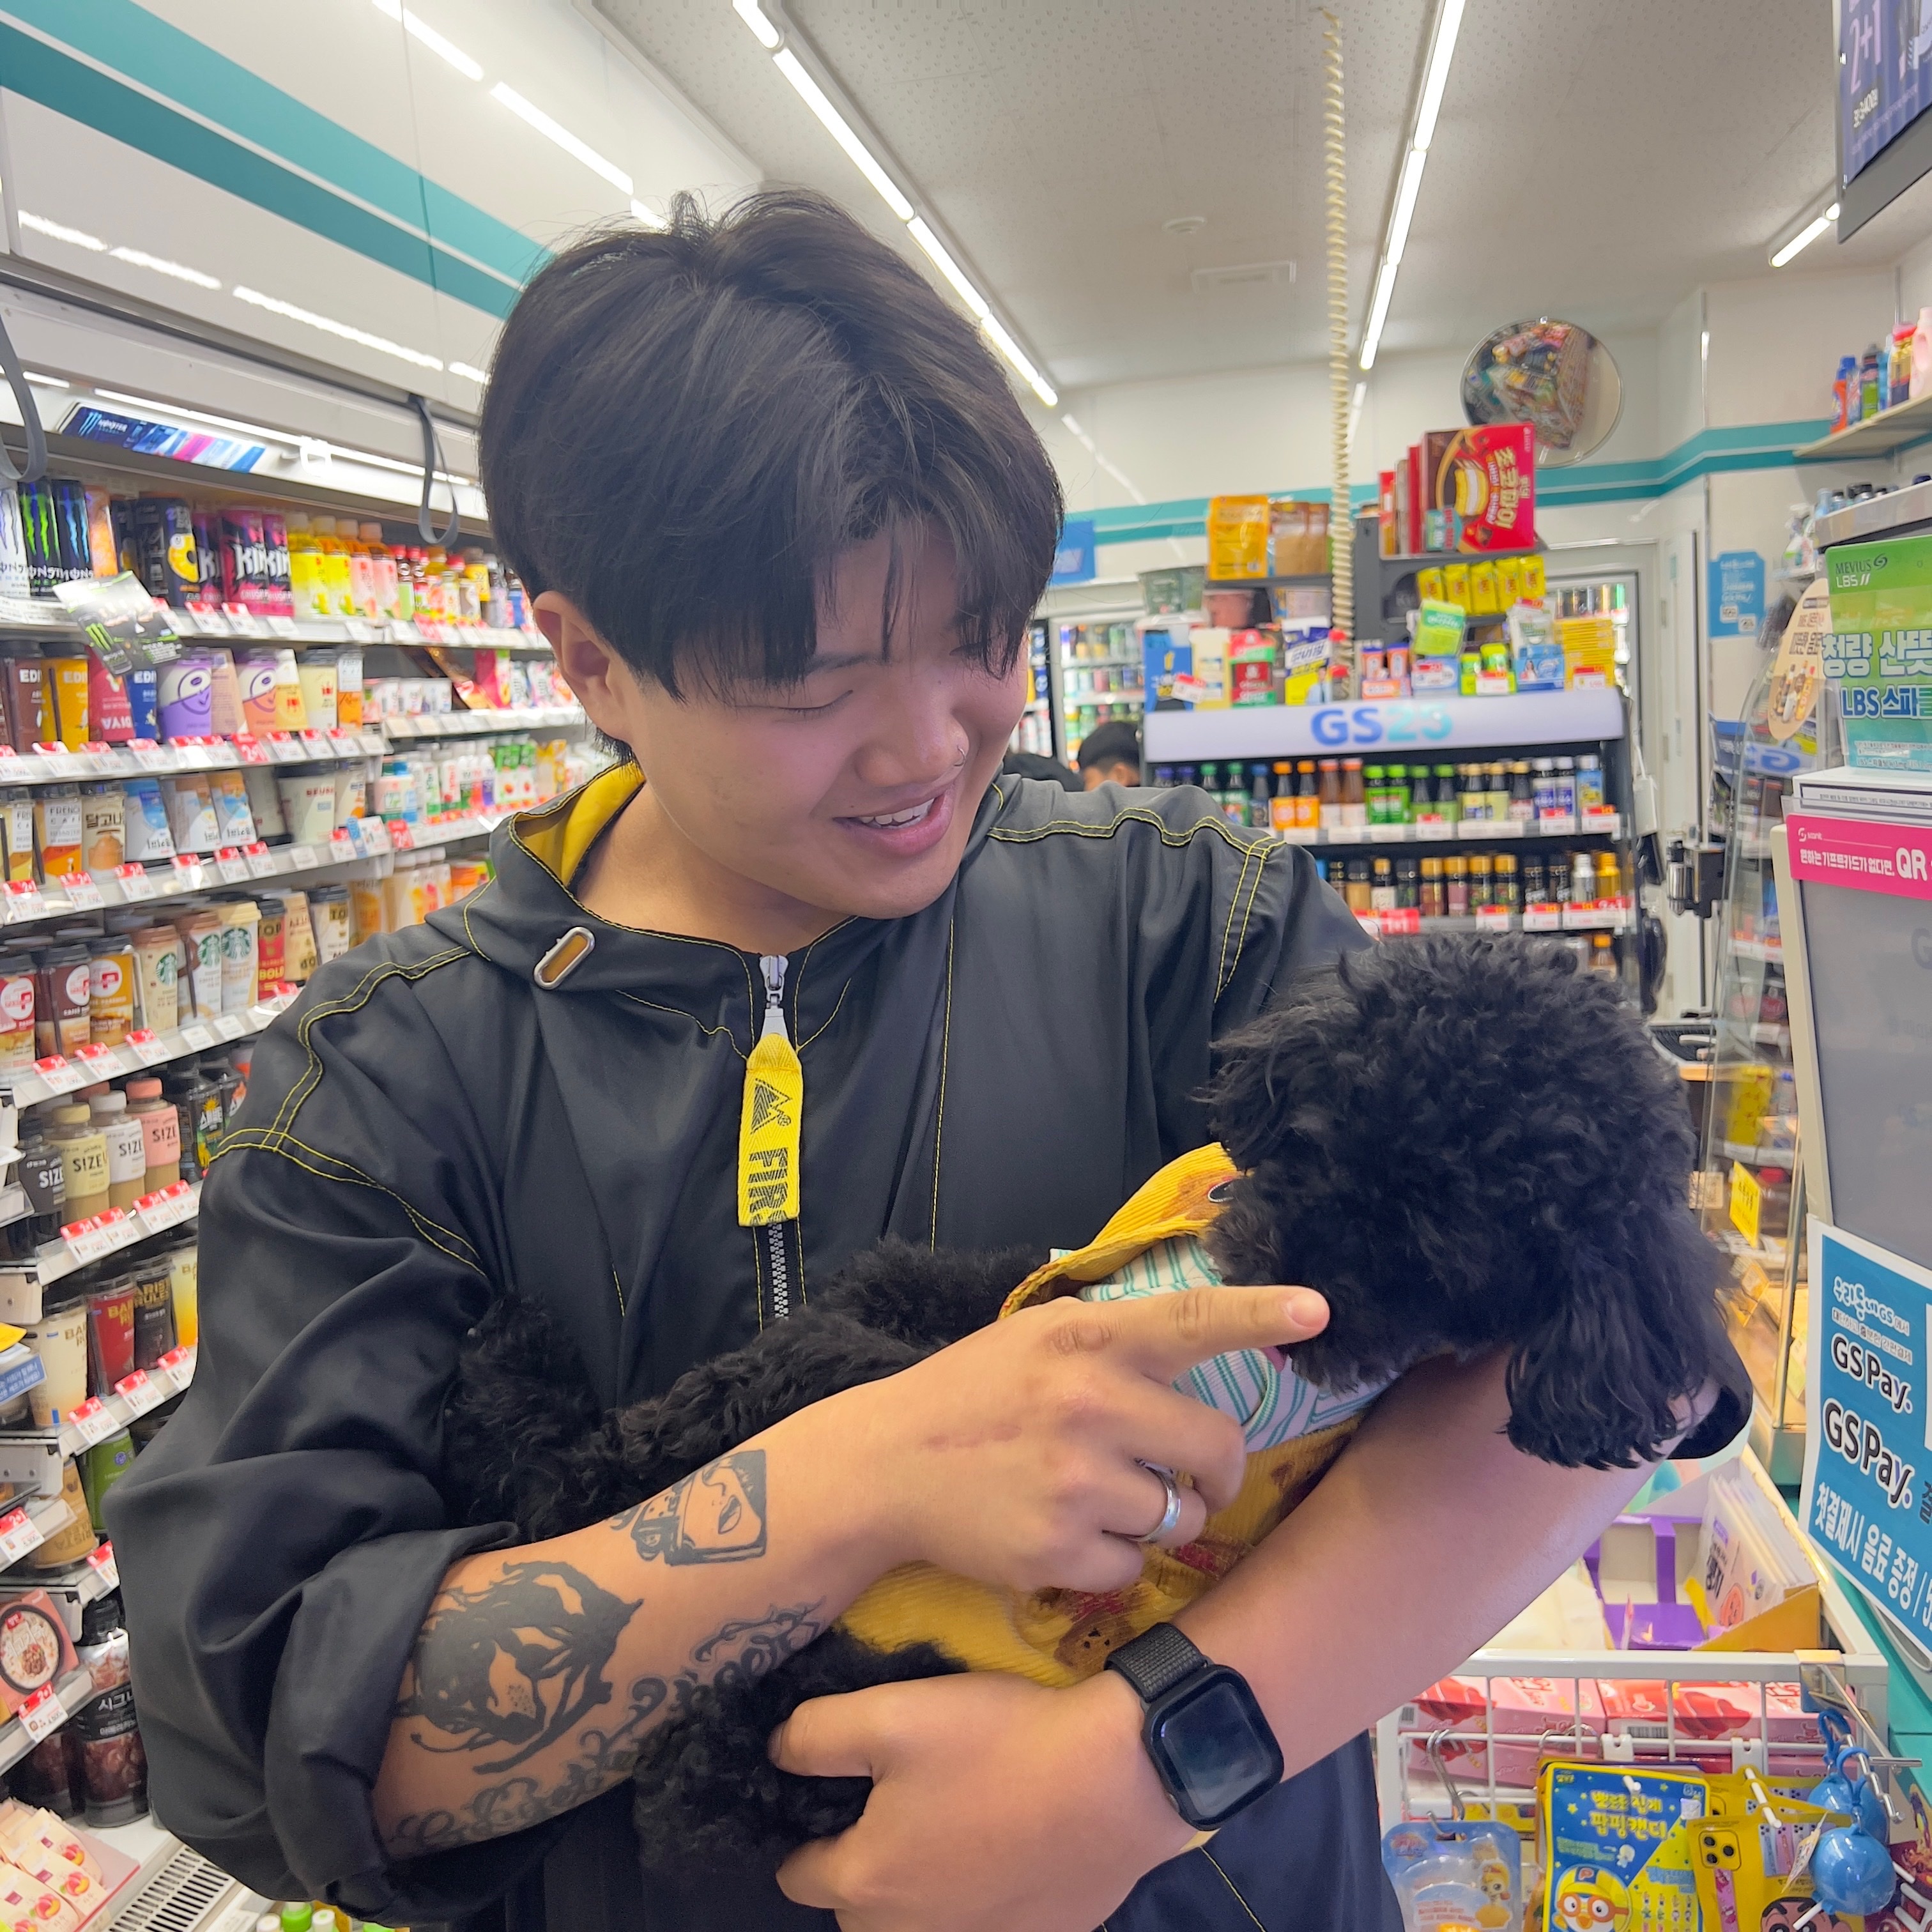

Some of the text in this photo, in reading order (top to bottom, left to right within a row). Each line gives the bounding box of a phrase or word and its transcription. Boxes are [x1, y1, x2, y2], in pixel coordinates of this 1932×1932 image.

[1849, 0, 1882, 94] 2+1
[1493, 447, 1517, 529] 초코파이
[1836, 559, 1871, 575] MEVIUS
[1836, 575, 1859, 588] LBS
[1821, 631, 1873, 679] 청량
[1841, 687, 1880, 717] LBS
[1310, 703, 1453, 747] GS25
[1800, 848, 1821, 866] 원하는
[1822, 852, 1867, 873] 기프트카드가
[1895, 847, 1928, 881] QR
[1814, 1481, 1865, 1562] 첫결제시
[1861, 1523, 1892, 1583] 음료
[1888, 1546, 1919, 1610] 증정
